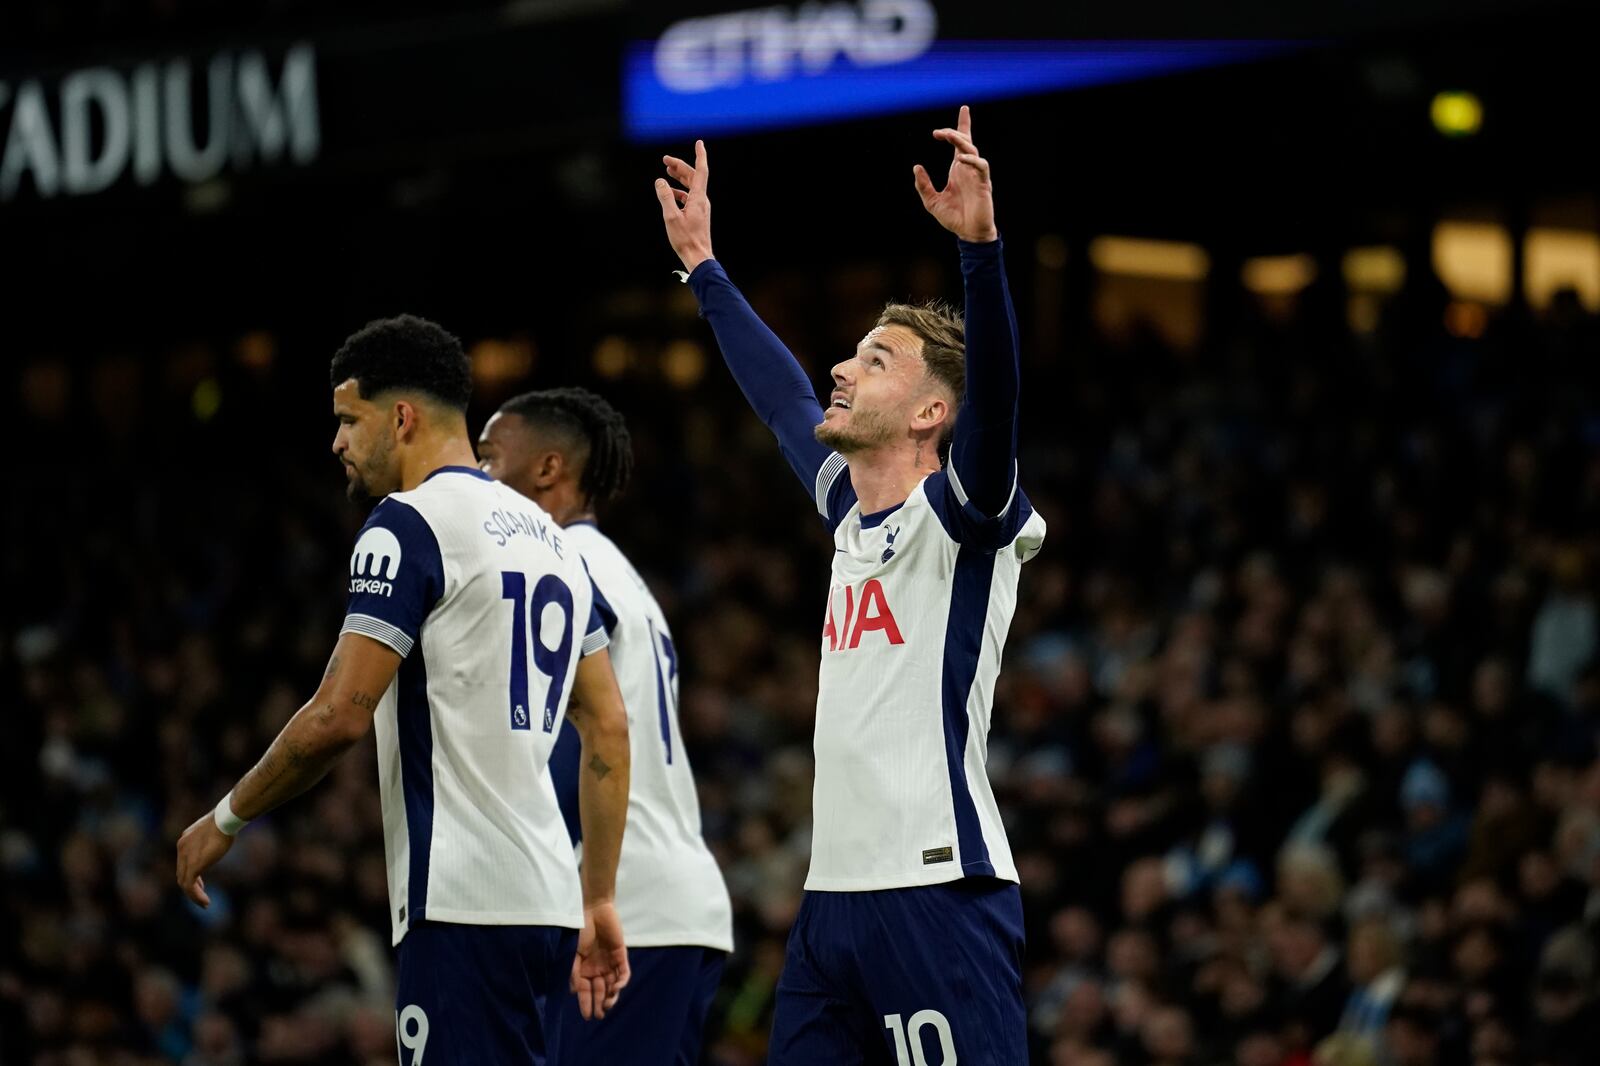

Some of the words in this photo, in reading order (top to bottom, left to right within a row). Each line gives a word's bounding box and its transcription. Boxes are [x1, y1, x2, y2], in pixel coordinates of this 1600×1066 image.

[0, 40, 322, 204] ADIUM
[501, 571, 574, 734] 19
[883, 1008, 958, 1066] 10
